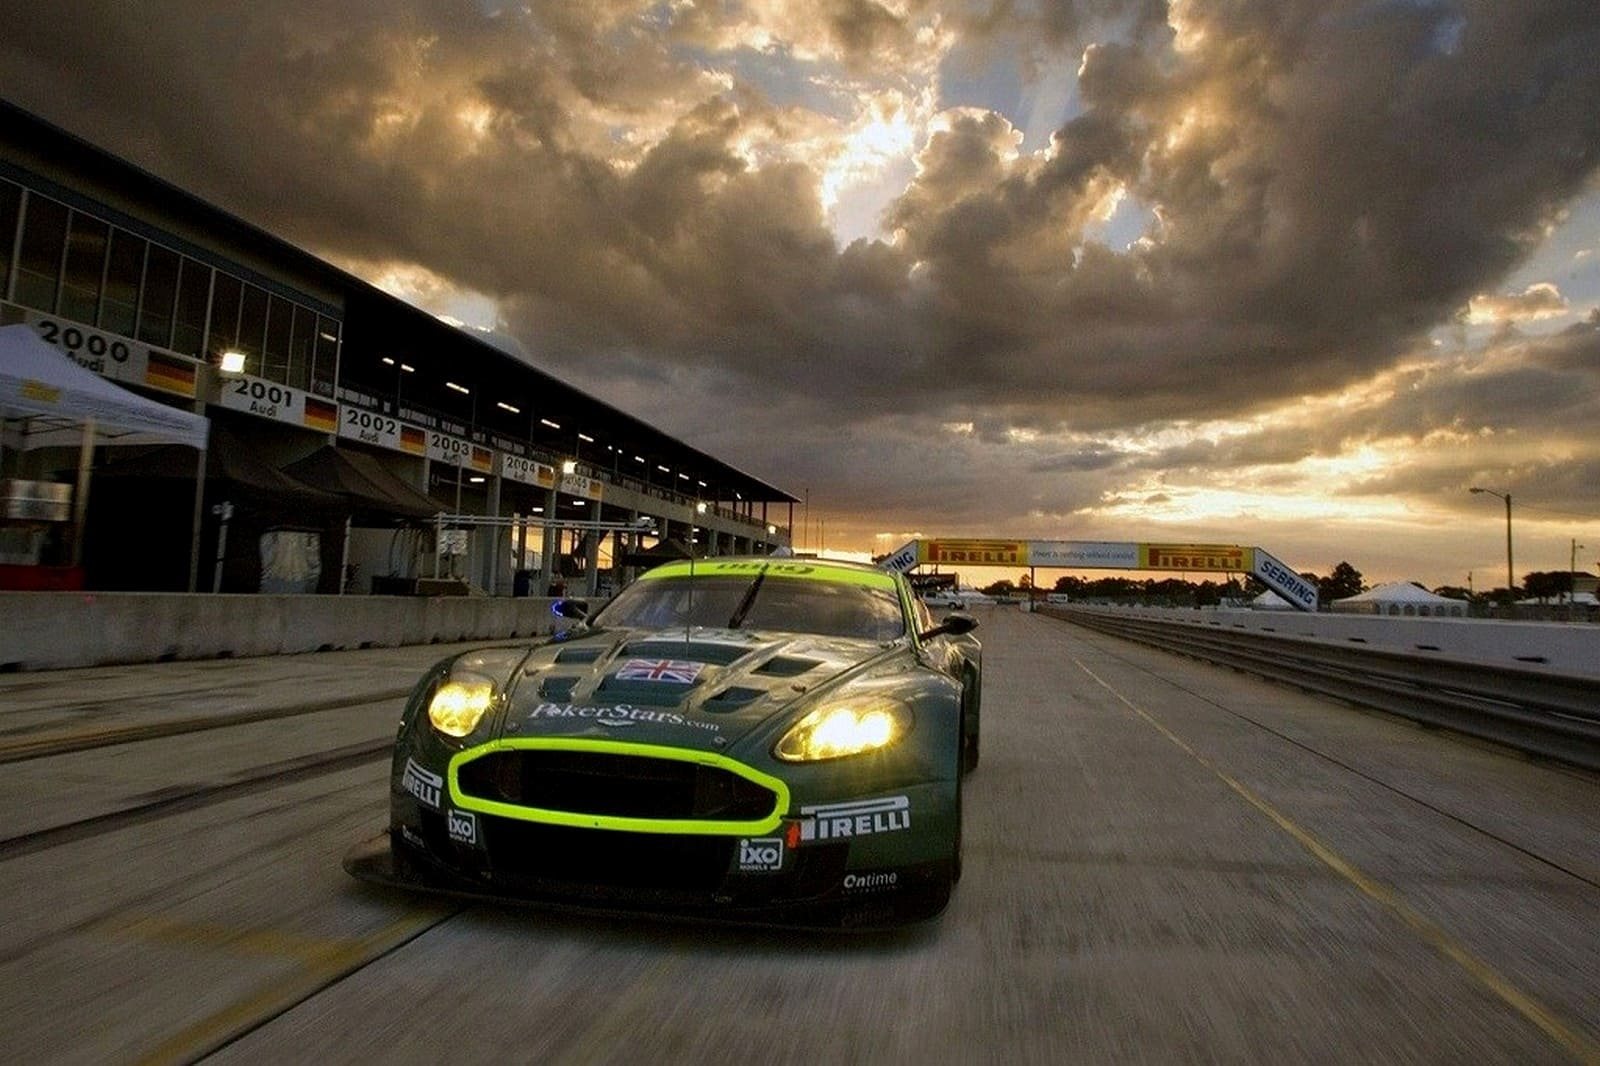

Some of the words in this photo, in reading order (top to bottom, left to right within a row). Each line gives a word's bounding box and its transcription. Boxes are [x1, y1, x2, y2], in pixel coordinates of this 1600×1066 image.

[38, 320, 129, 363] 2000
[234, 379, 292, 408] 2001
[249, 400, 277, 417] Audi
[347, 409, 396, 435] 2002
[432, 434, 469, 456] 2003
[507, 456, 535, 472] 2004
[887, 551, 914, 572] ING
[928, 543, 1018, 562] PIRELLI
[1149, 548, 1243, 569] PIRELLI
[1260, 561, 1315, 605] SEBRING
[800, 795, 910, 841] PIRELLI
[843, 872, 897, 889] Ontime
